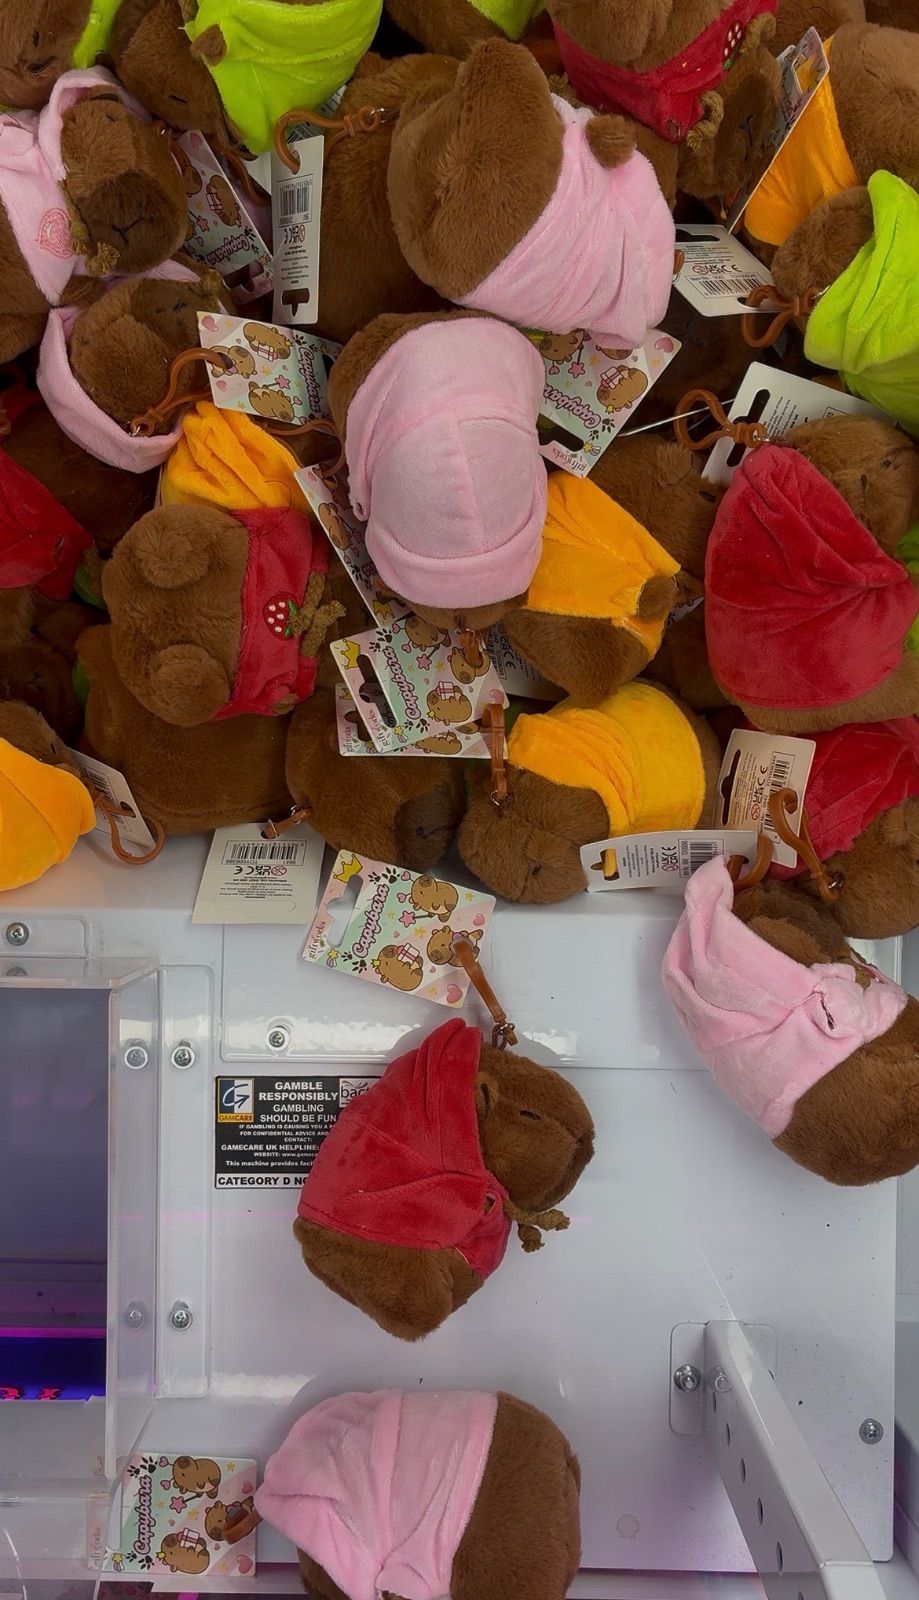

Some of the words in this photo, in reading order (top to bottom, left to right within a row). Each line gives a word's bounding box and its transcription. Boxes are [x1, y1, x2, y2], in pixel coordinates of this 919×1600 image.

[298, 347, 320, 413] Capybara
[543, 383, 601, 429] Capybar
[383, 646, 422, 720] Capybara
[352, 883, 390, 958] Capybara
[258, 1092, 338, 1100] RESPONSIBLY
[274, 1082, 323, 1090] GAMBLE
[260, 1114, 300, 1122] SHOULD
[302, 1114, 315, 1122] BE
[318, 1114, 337, 1122] FUN
[273, 1104, 324, 1112] GAMBLING
[218, 1177, 279, 1185] CATEGORY
[283, 1177, 290, 1185] D
[133, 1474, 156, 1555] Capybara
